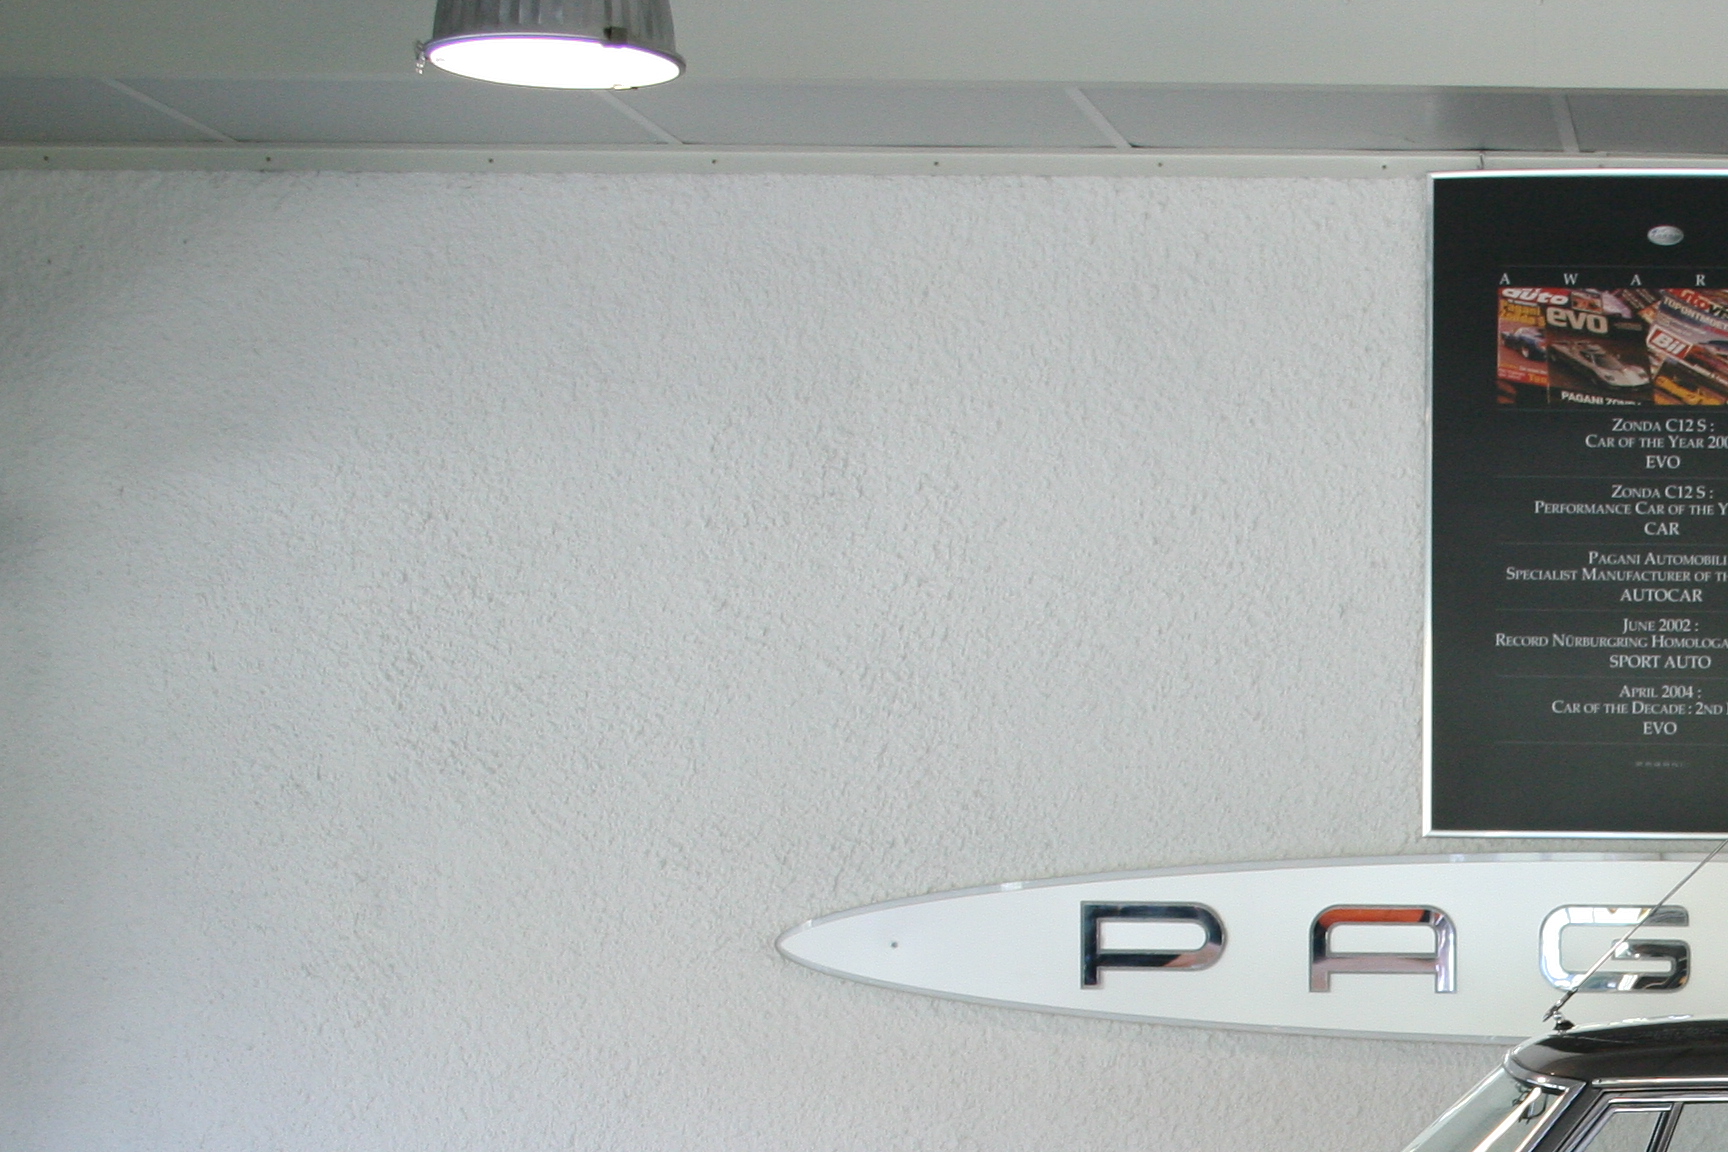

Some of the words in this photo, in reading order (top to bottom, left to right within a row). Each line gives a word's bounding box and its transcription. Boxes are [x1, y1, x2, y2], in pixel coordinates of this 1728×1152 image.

[1546, 307, 1608, 334] evo
[1561, 390, 1603, 406] PAGANI
[1611, 417, 1662, 432] ZONDA
[1665, 418, 1694, 433] C12
[1584, 433, 1615, 449] CAR
[1617, 437, 1635, 448] OF
[1638, 437, 1665, 448] THE
[1667, 434, 1705, 449] YEAR
[1645, 454, 1681, 470] EVO
[1611, 484, 1661, 499] ZONDA
[1664, 484, 1693, 499] C12
[1534, 500, 1632, 515] PERFORMANCE
[1634, 501, 1665, 515] CAR
[1667, 504, 1685, 516] OF
[1688, 504, 1715, 516] THE
[1643, 521, 1680, 536] CAR
[1588, 550, 1641, 565] PAGANI
[1505, 566, 1578, 581] SPECIALIST
[1581, 567, 1691, 582] MANUFACTURER
[1693, 571, 1712, 582] OF
[1619, 588, 1703, 603] AUTOCAR
[1622, 617, 1655, 634] JUNE
[1495, 632, 1549, 647] RECORD
[1609, 654, 1661, 669] SPORT
[1663, 655, 1712, 669] AUTO
[1618, 684, 1658, 698] APRIL
[1551, 699, 1581, 714] CAR
[1583, 702, 1600, 714] OF
[1602, 703, 1629, 714] THE
[1643, 721, 1678, 736] EVO
